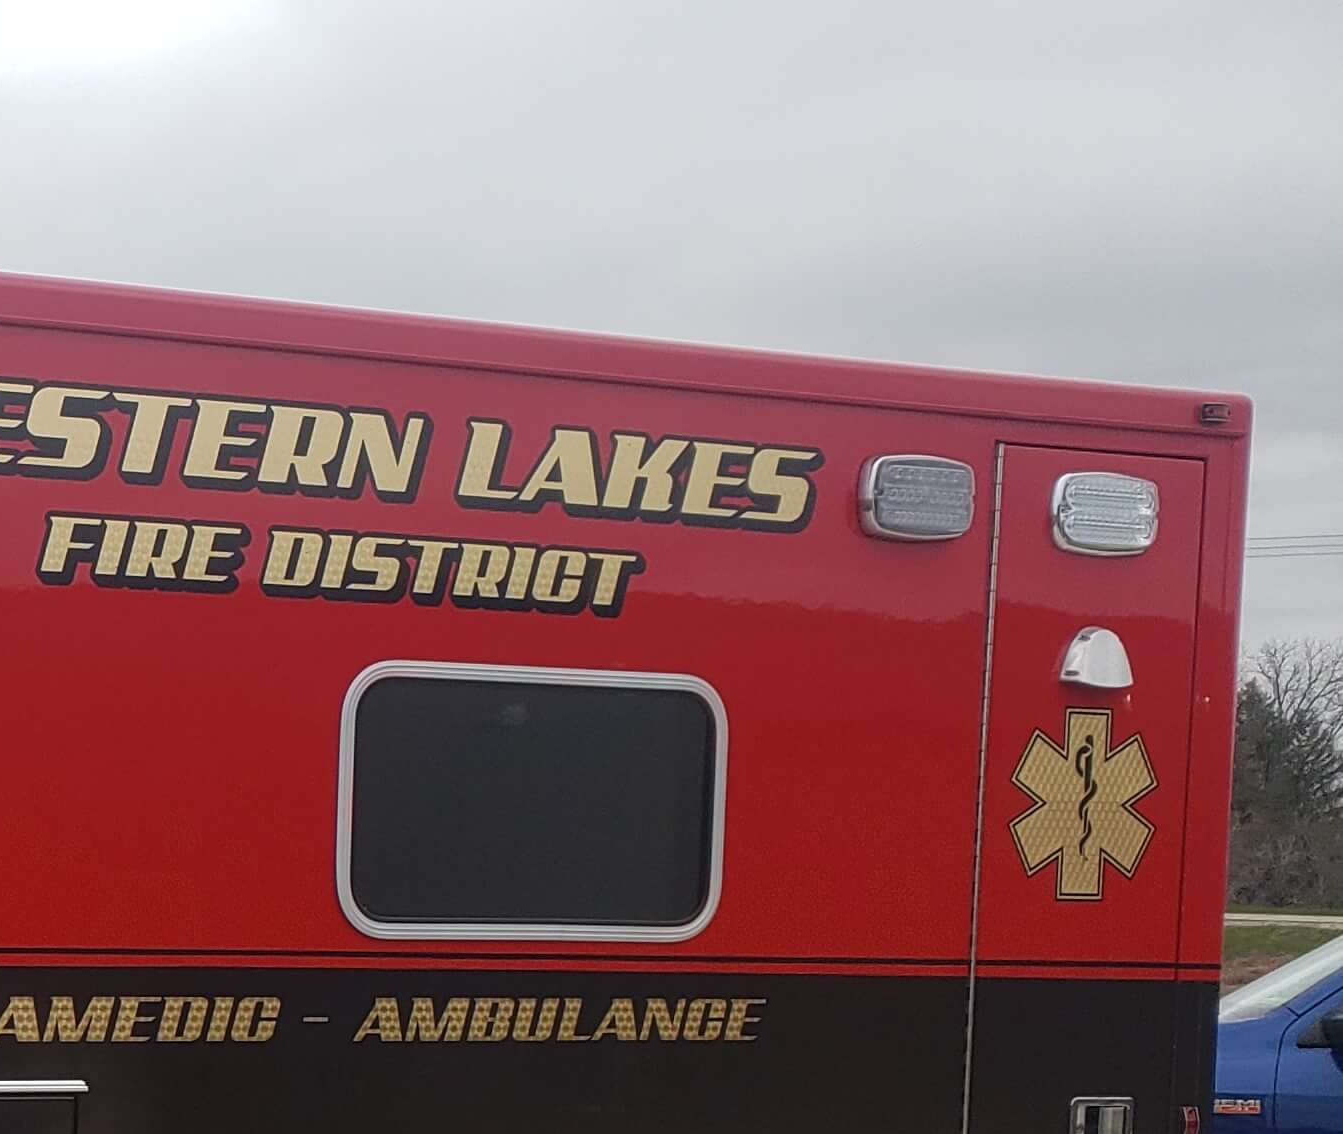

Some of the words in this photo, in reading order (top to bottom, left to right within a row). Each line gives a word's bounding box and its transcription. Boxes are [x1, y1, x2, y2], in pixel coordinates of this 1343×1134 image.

[454, 418, 822, 527] LAKES
[39, 511, 248, 588] FIRE
[262, 525, 640, 612] DISTRICT
[352, 995, 767, 1043] AMBULANCE
